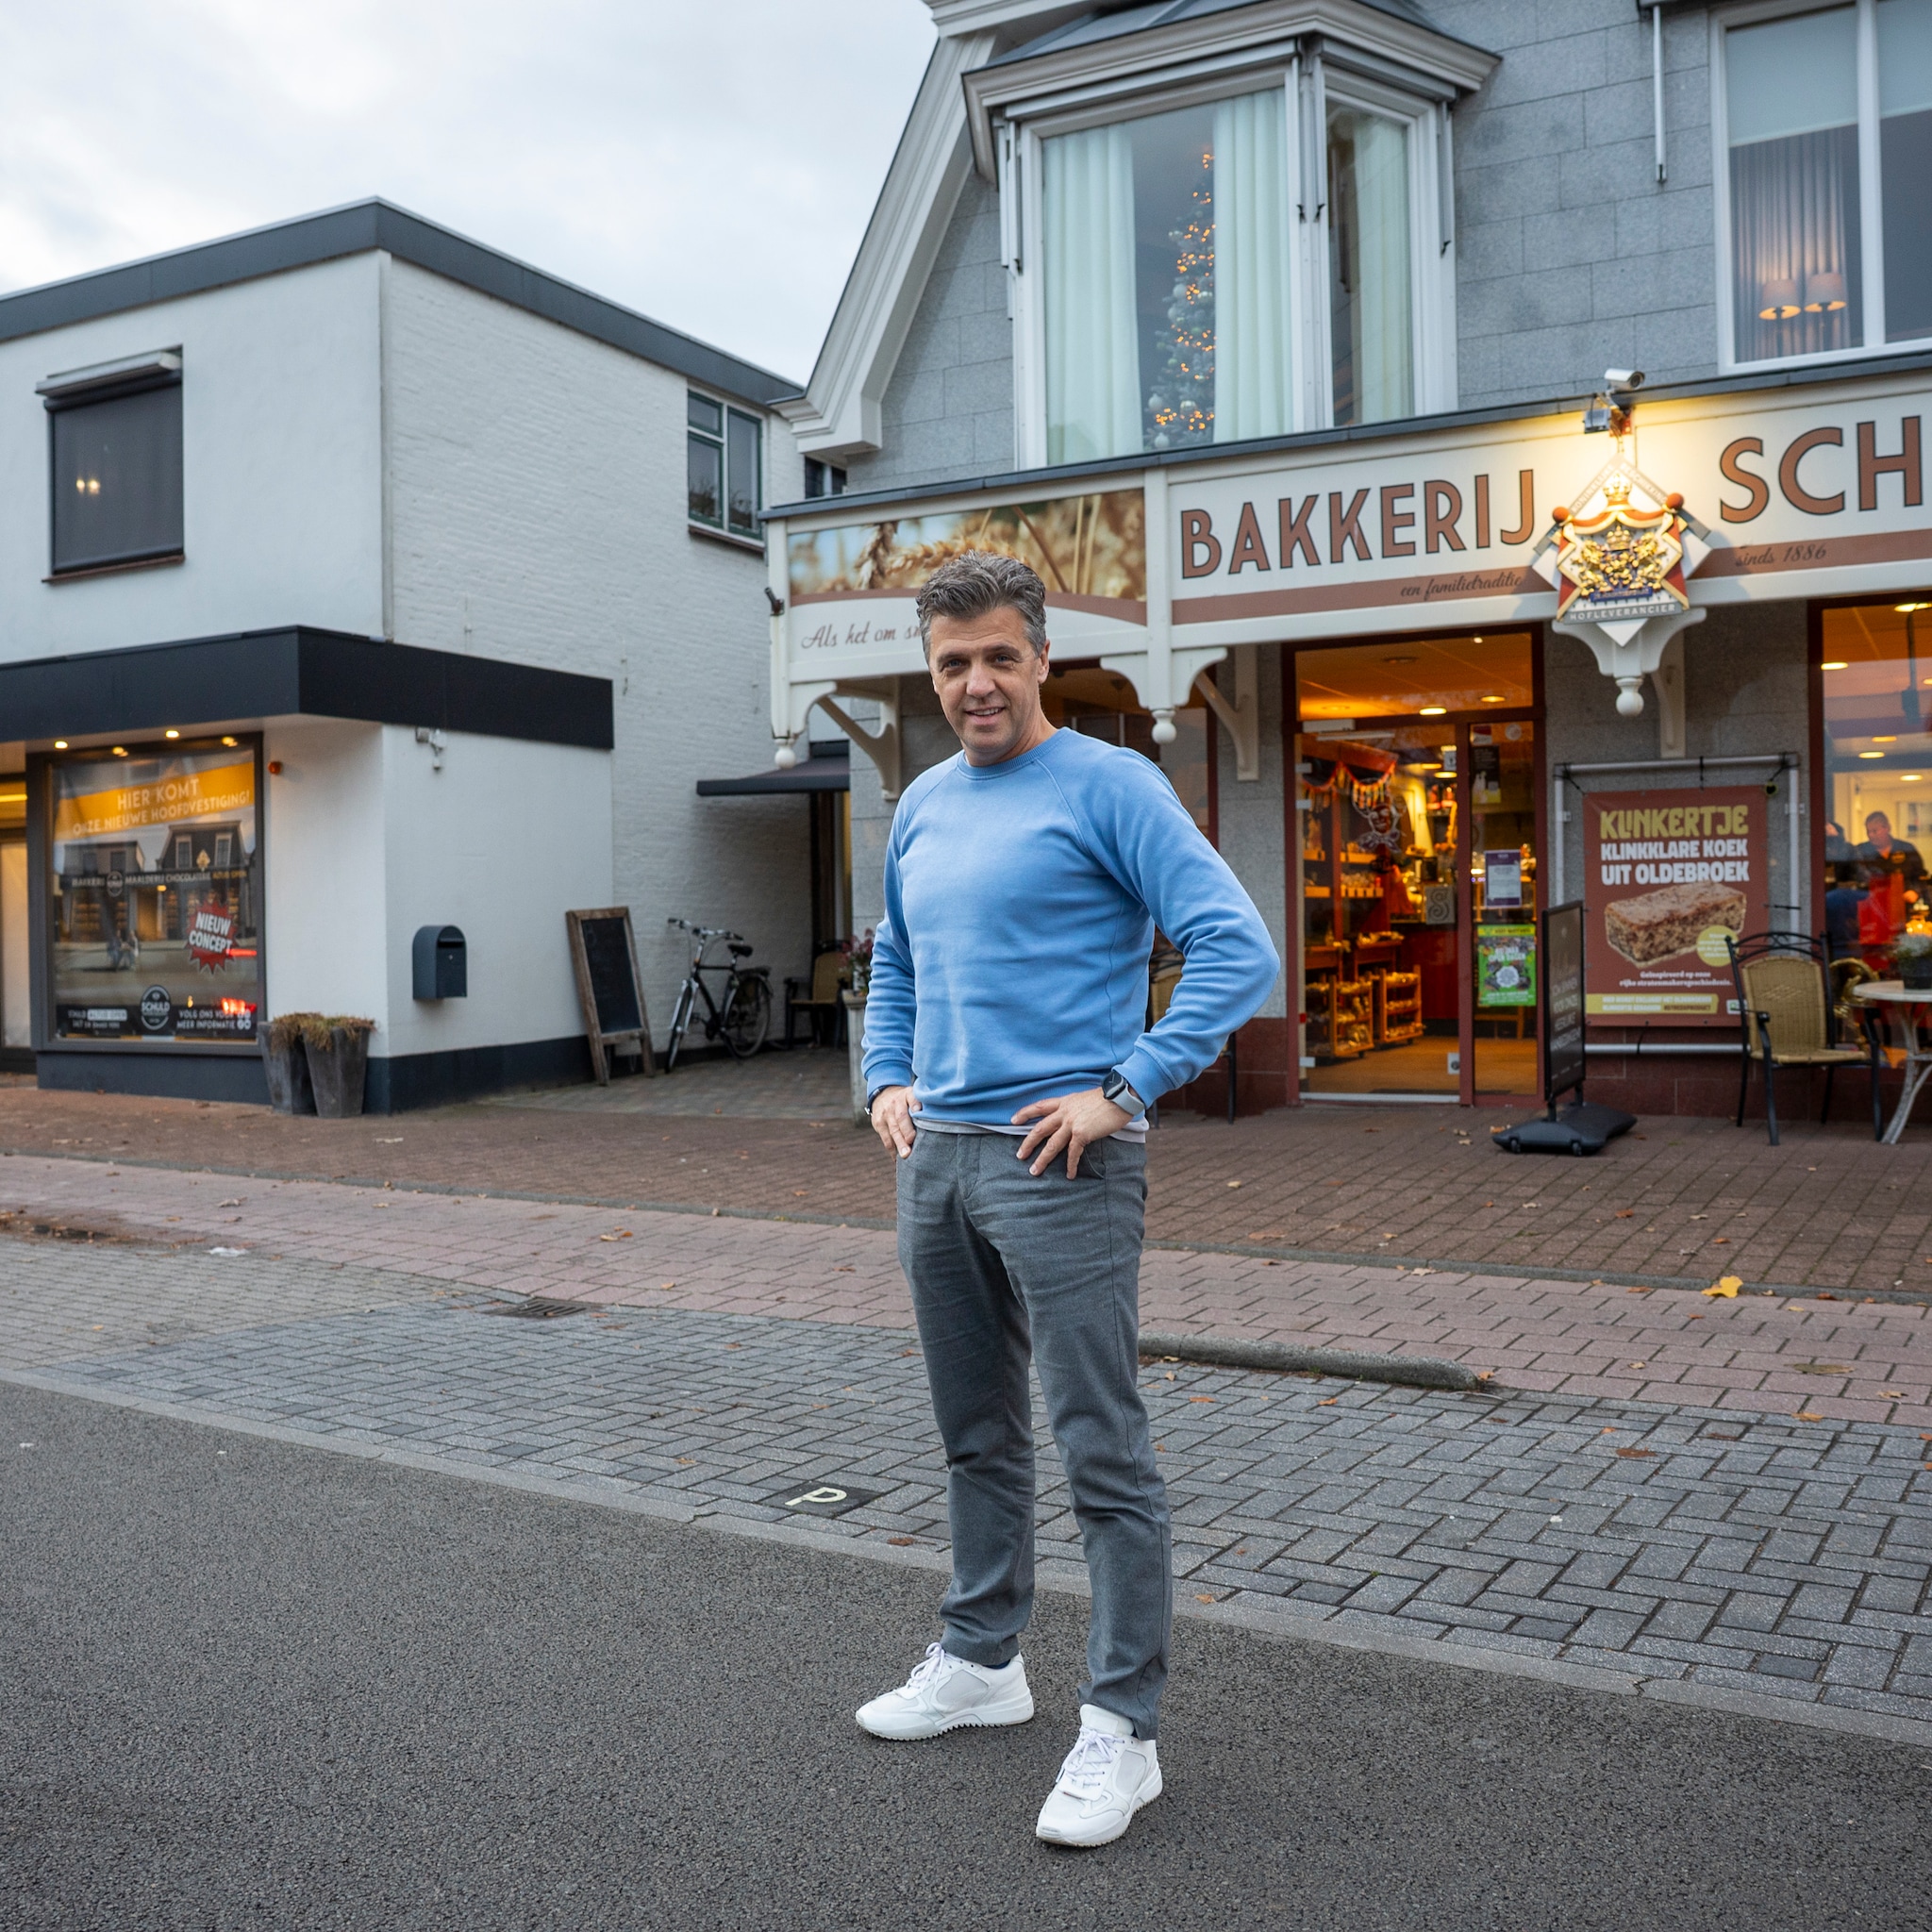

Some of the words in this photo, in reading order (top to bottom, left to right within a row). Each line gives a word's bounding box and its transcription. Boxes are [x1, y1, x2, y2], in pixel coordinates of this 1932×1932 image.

[1181, 469, 1535, 579] BAKKERIJ
[1720, 415, 1924, 524] SCH
[1736, 544, 1774, 567] sinds
[1783, 543, 1826, 563] 1886
[1401, 584, 1422, 598] een
[1424, 572, 1523, 602] familietraditie
[1570, 604, 1675, 621] HOFLEVERANCIER
[801, 624, 838, 649] Als
[845, 621, 871, 644] het
[874, 627, 896, 641] om
[117, 789, 151, 811] HIER
[157, 778, 199, 803] KOMT
[104, 811, 147, 828] NIEUWE
[151, 790, 250, 822] HOOFDVESTIGING!
[1600, 805, 1749, 840] KLINKERTJE
[1600, 840, 1700, 861] KLINKKLARE
[1703, 838, 1748, 858] KOEK
[1601, 863, 1632, 886] UIT
[1635, 860, 1750, 885] OLDEBROEK
[195, 911, 231, 936] NIEUW
[189, 930, 232, 954] CONCEPT
[785, 1487, 847, 1507] P
